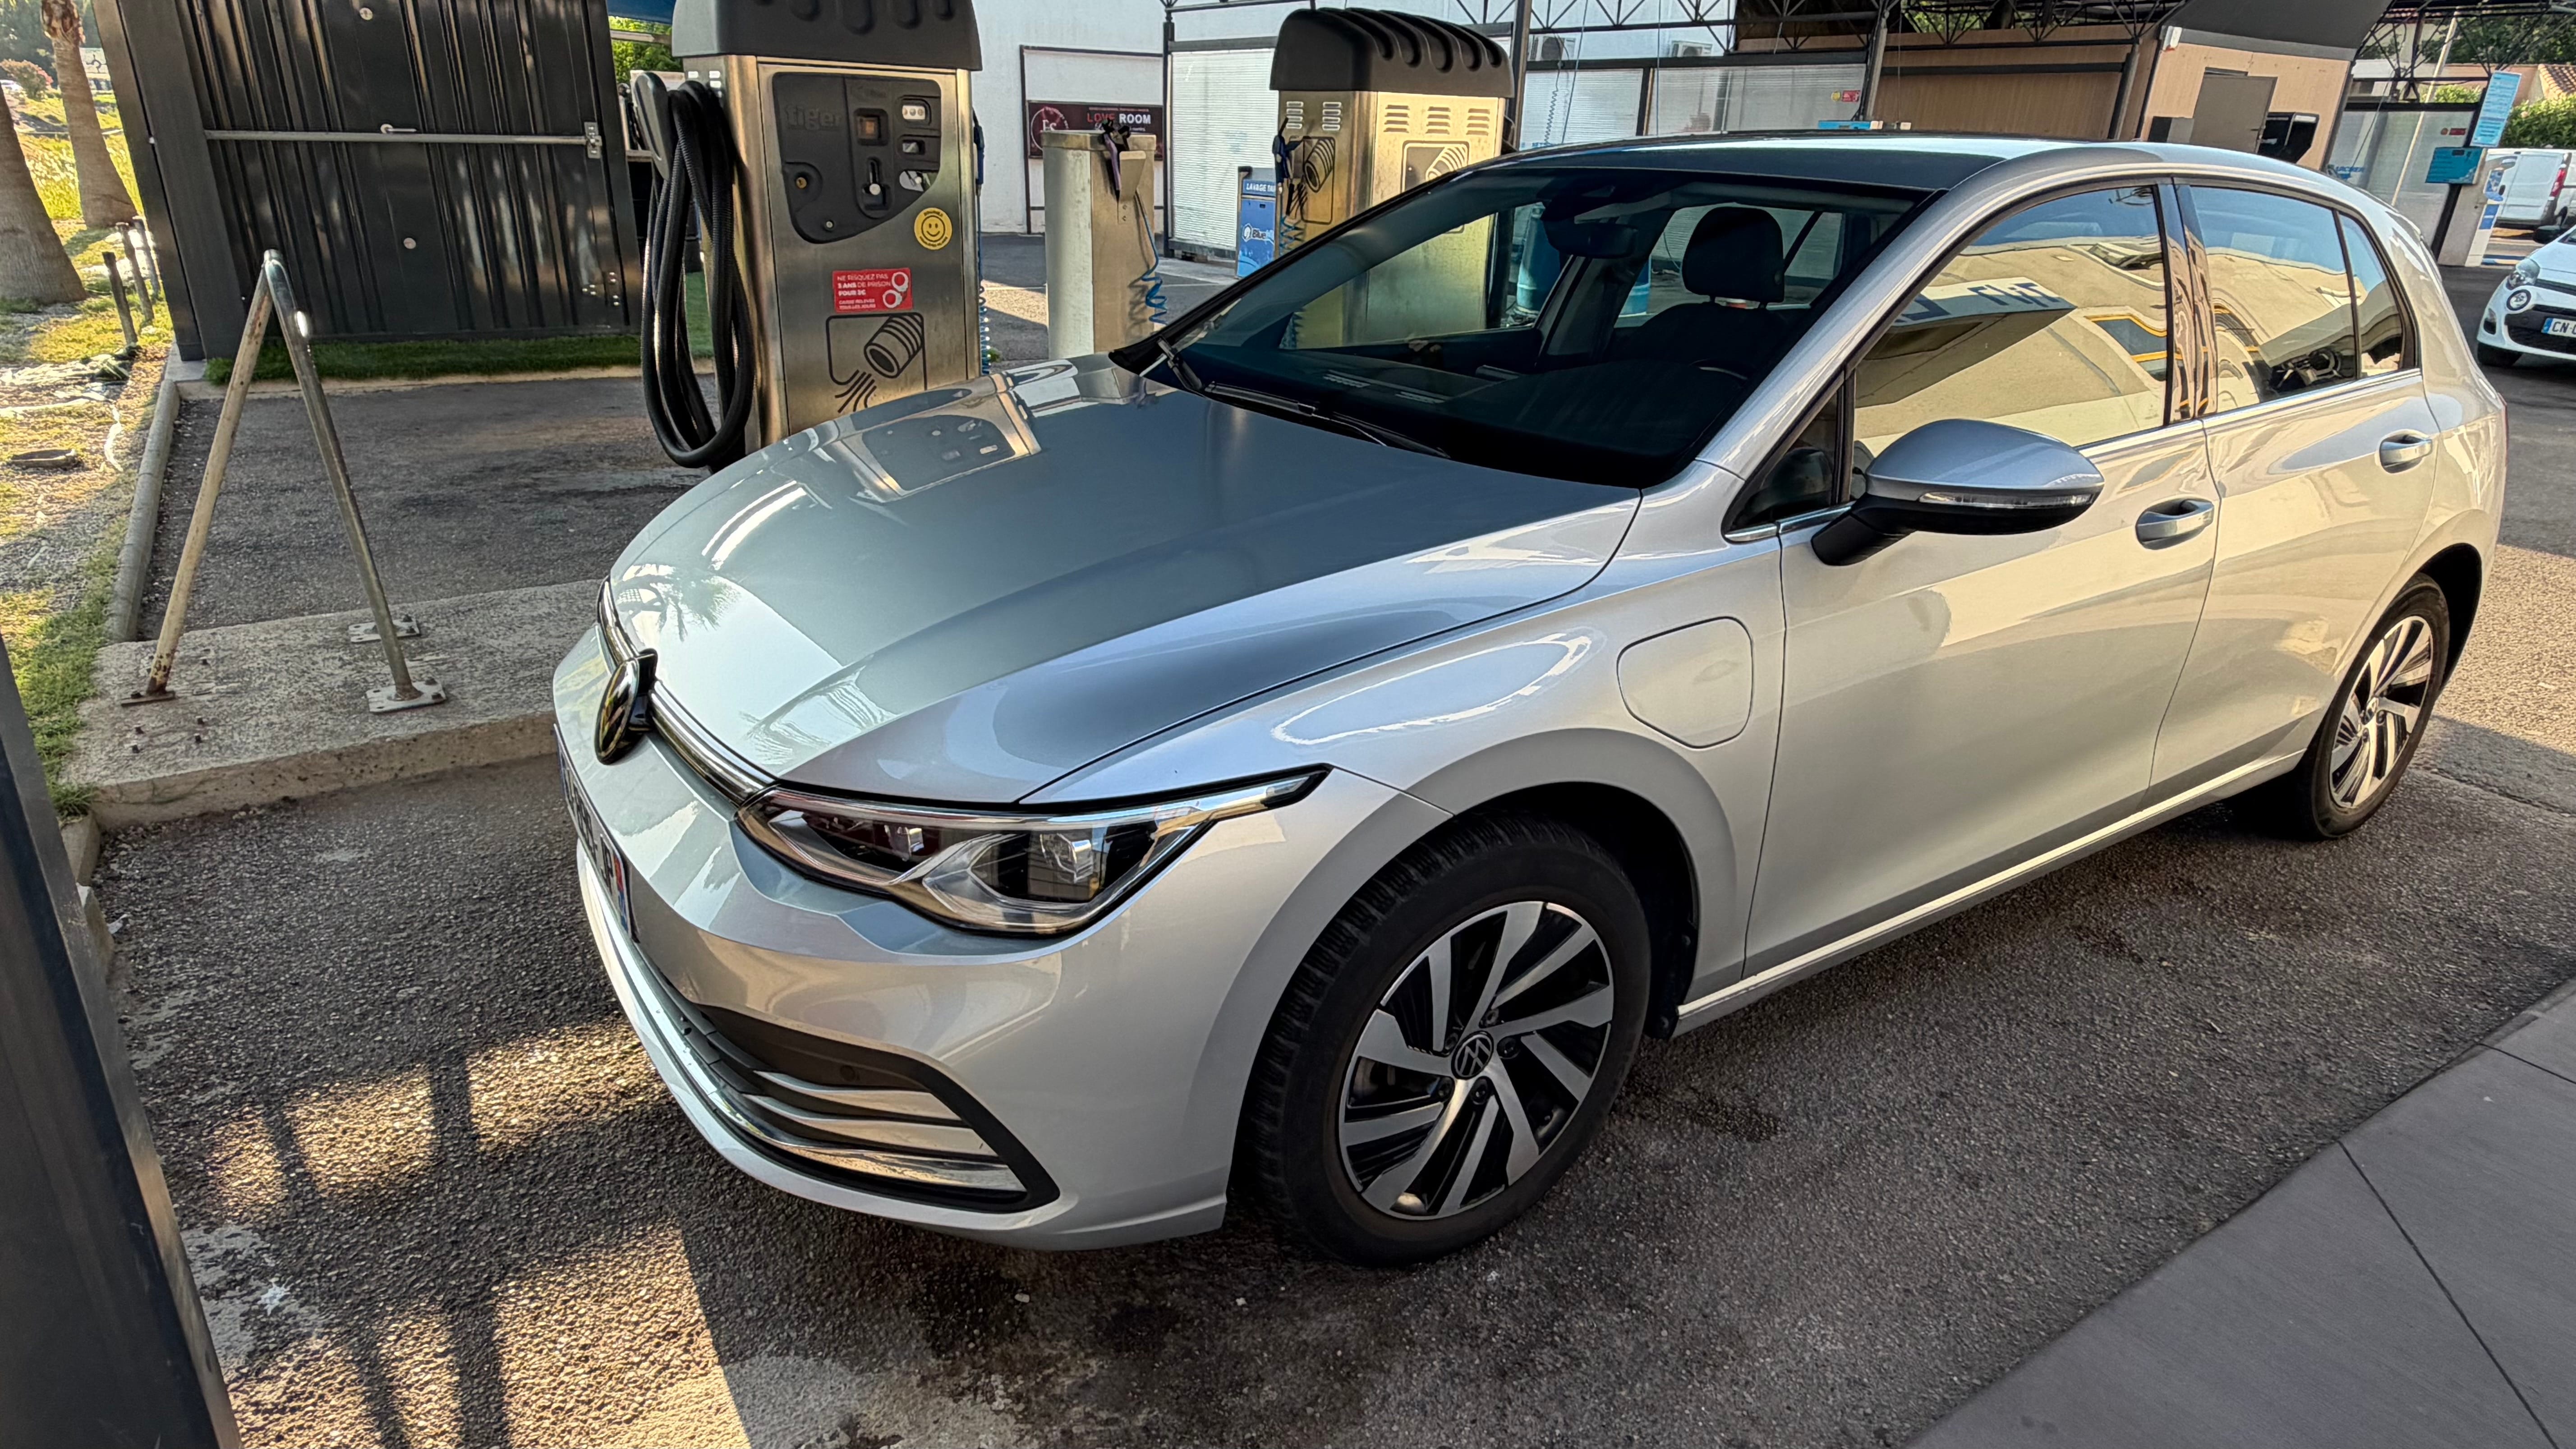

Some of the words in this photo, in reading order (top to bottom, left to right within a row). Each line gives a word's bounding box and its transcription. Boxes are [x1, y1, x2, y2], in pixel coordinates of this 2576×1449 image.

[1087, 113, 1116, 123] LOVE
[1118, 113, 1151, 124] ROOM
[1246, 183, 1266, 192] LAVAGE
